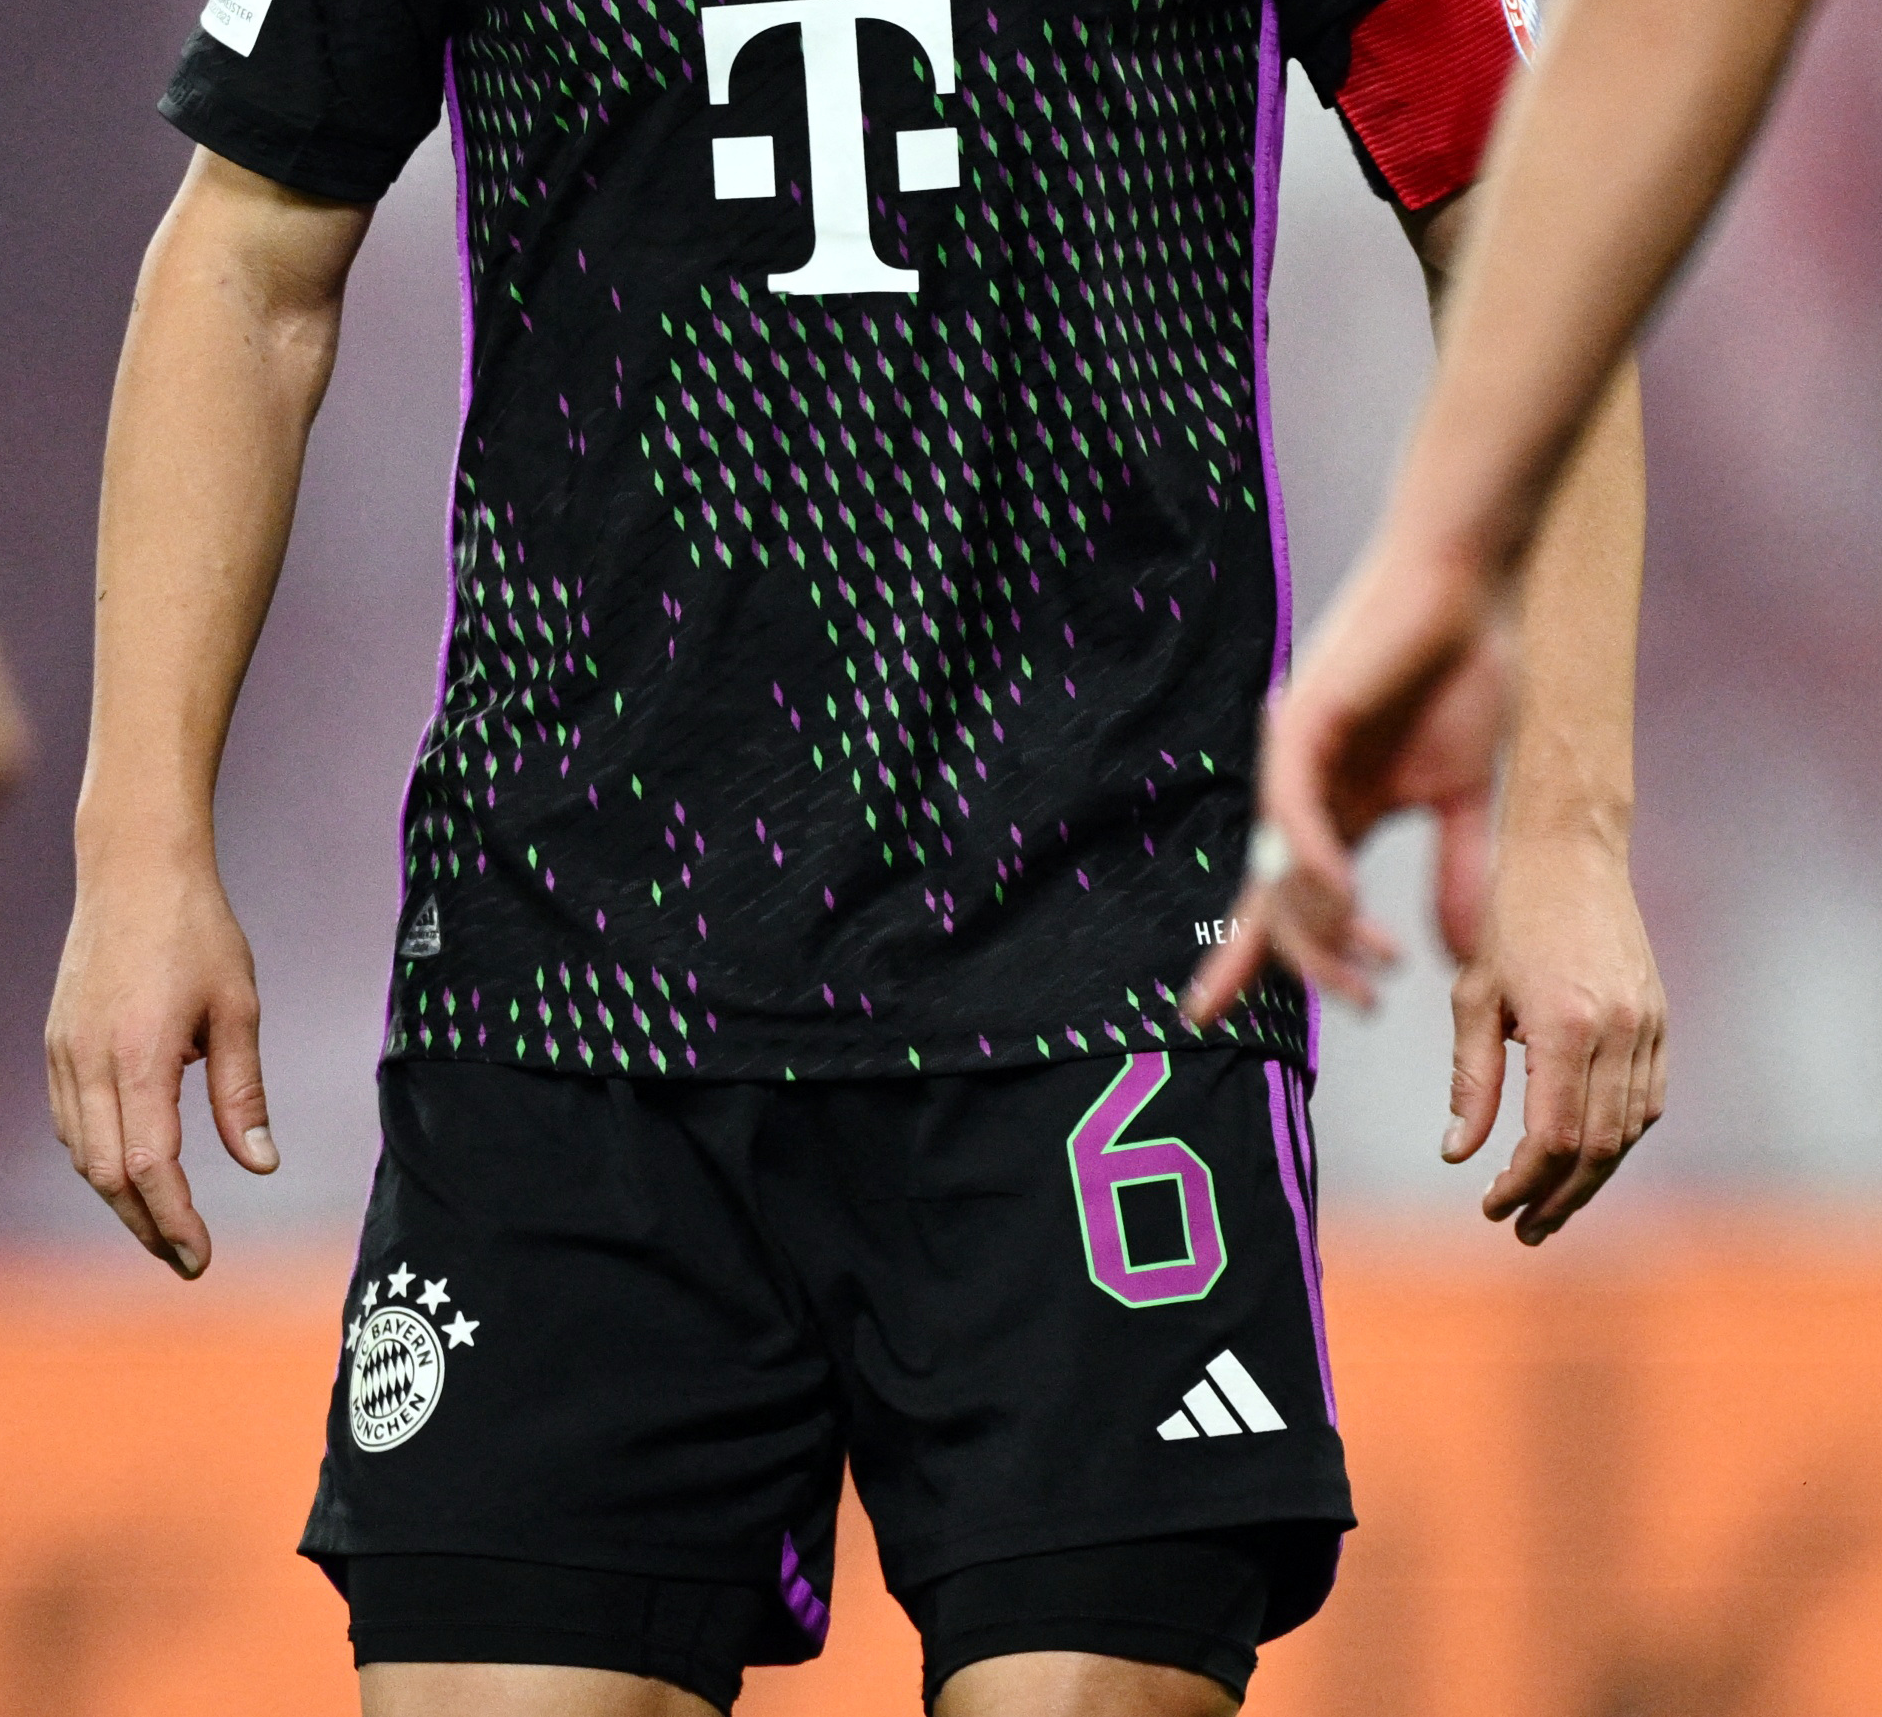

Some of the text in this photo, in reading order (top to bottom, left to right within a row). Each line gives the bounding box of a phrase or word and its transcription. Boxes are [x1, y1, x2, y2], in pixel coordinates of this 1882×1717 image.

[1194, 917, 1251, 946] HEA
[1066, 1051, 1228, 1310] 6
[371, 1318, 433, 1368] BAYERN
